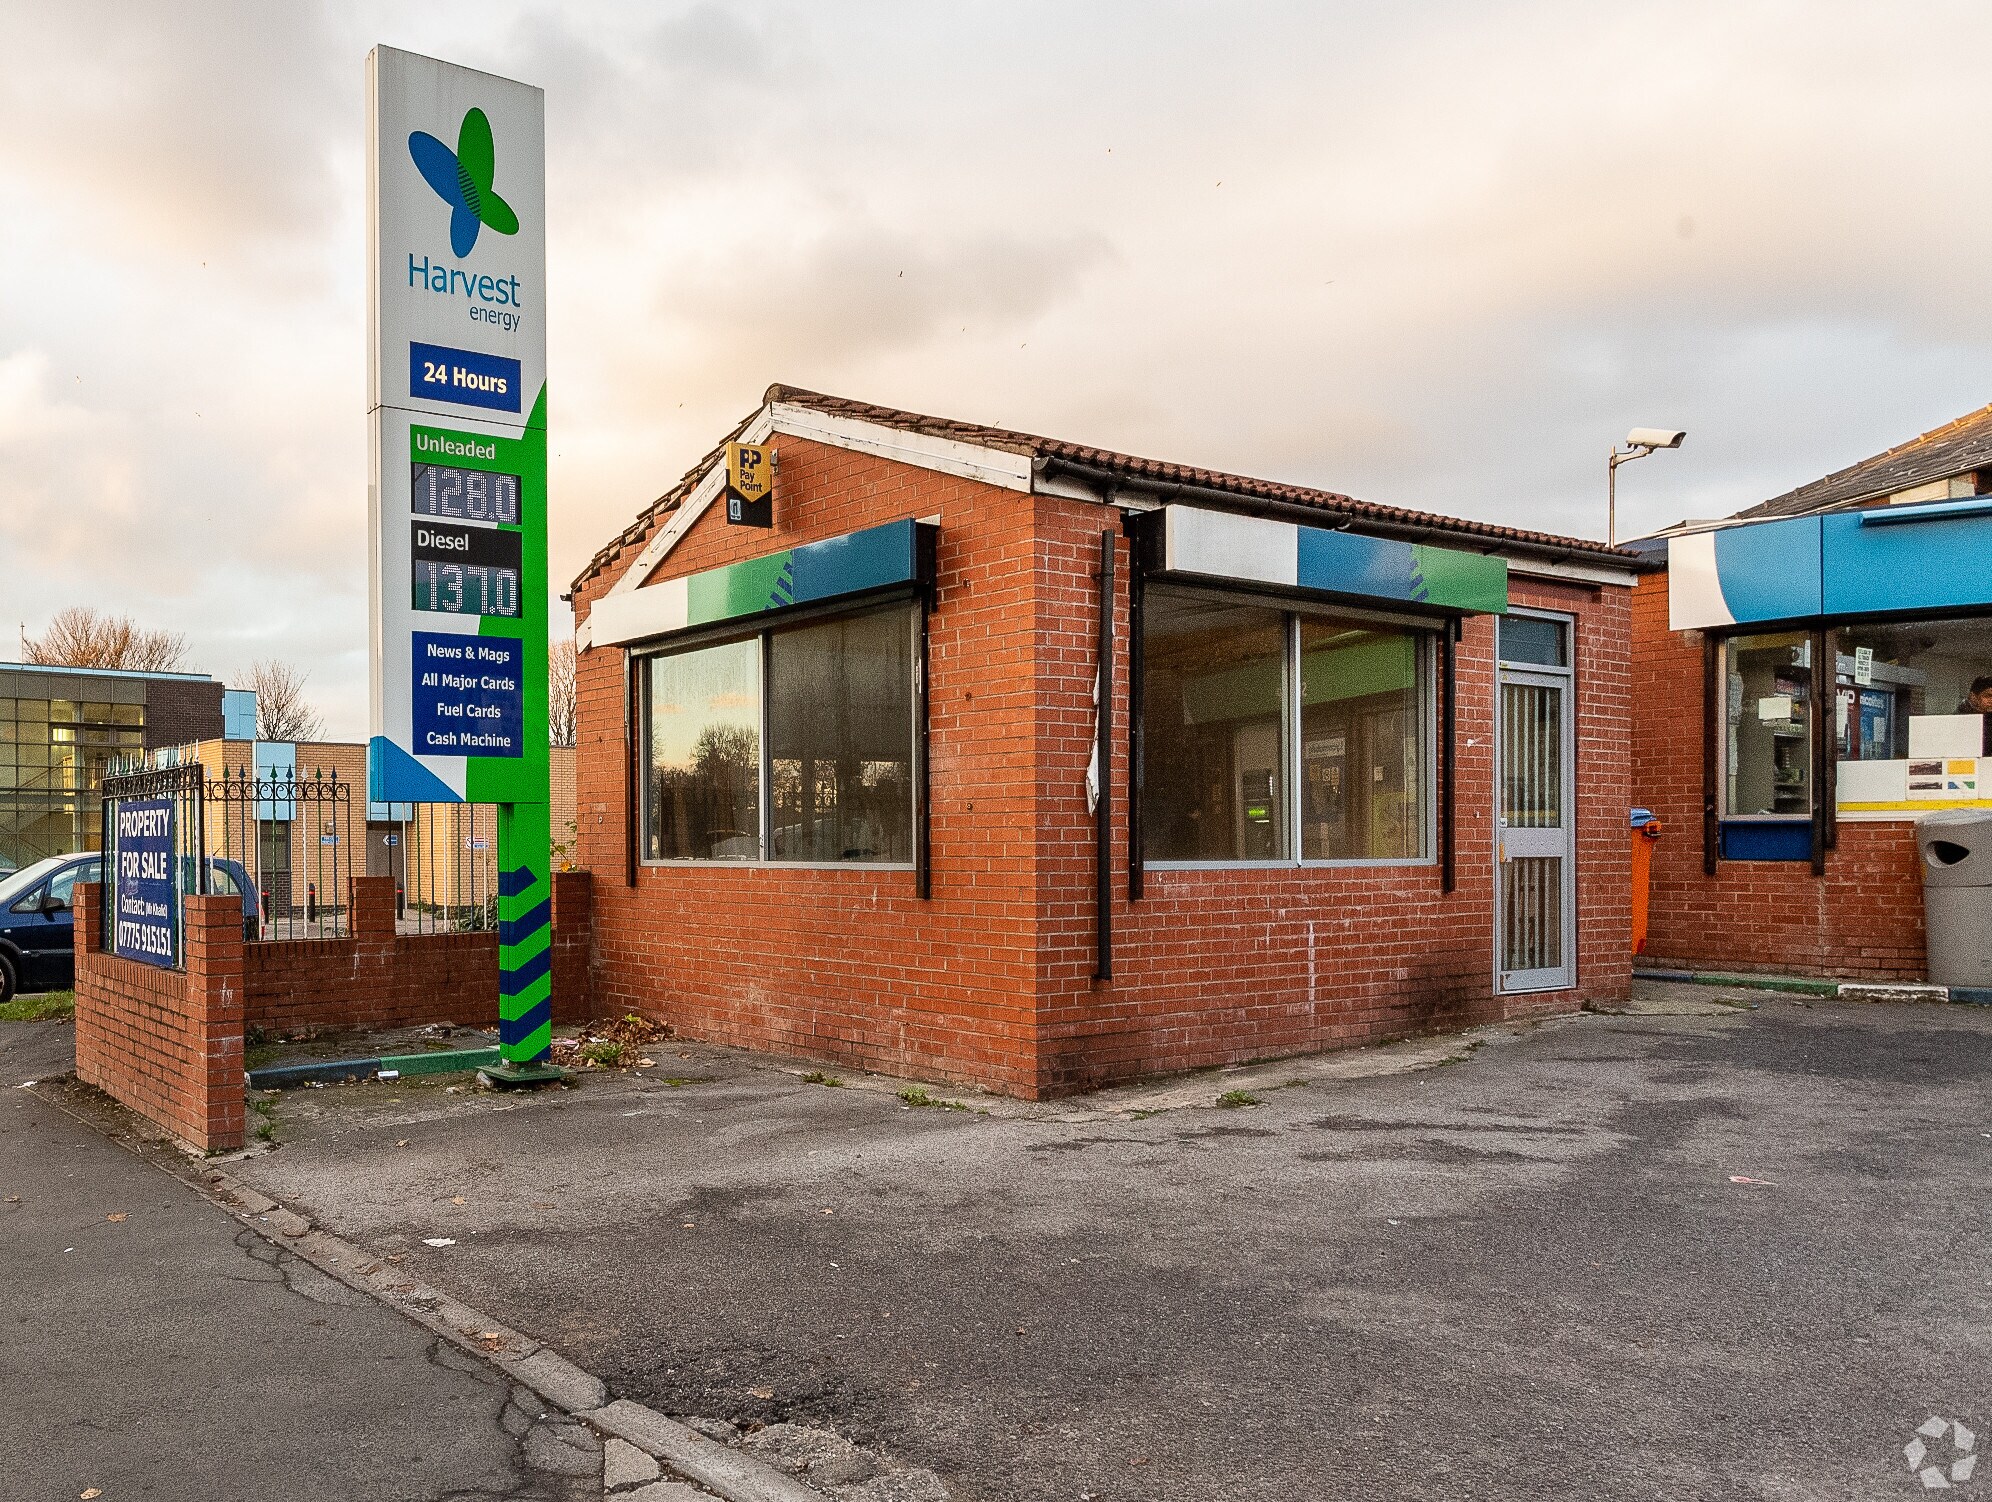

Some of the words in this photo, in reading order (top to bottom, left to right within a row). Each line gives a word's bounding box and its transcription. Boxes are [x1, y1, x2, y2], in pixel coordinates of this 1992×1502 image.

[408, 253, 521, 308] Harvest
[469, 305, 521, 333] energy
[423, 362, 448, 384] 24
[453, 366, 507, 394] Hours
[416, 433, 496, 460] Unleaded
[740, 469, 755, 483] Pay
[740, 480, 762, 492] Point
[427, 466, 516, 522] 128.0
[417, 530, 469, 551] Diesel
[427, 562, 517, 616] 137.0
[427, 643, 462, 659] News
[465, 646, 475, 660] &
[478, 647, 510, 664] Mags
[422, 673, 438, 686] All
[442, 673, 478, 691] Major
[481, 676, 515, 690] Cards
[437, 702, 463, 717] Fuel
[466, 704, 501, 718] Cards
[426, 731, 457, 745] Cash
[460, 732, 511, 747] Machine
[119, 809, 170, 838] PROPERTY
[121, 852, 140, 878] FOR
[141, 852, 167, 880] SALE
[119, 920, 140, 950] 07775
[141, 924, 172, 956] 915151
